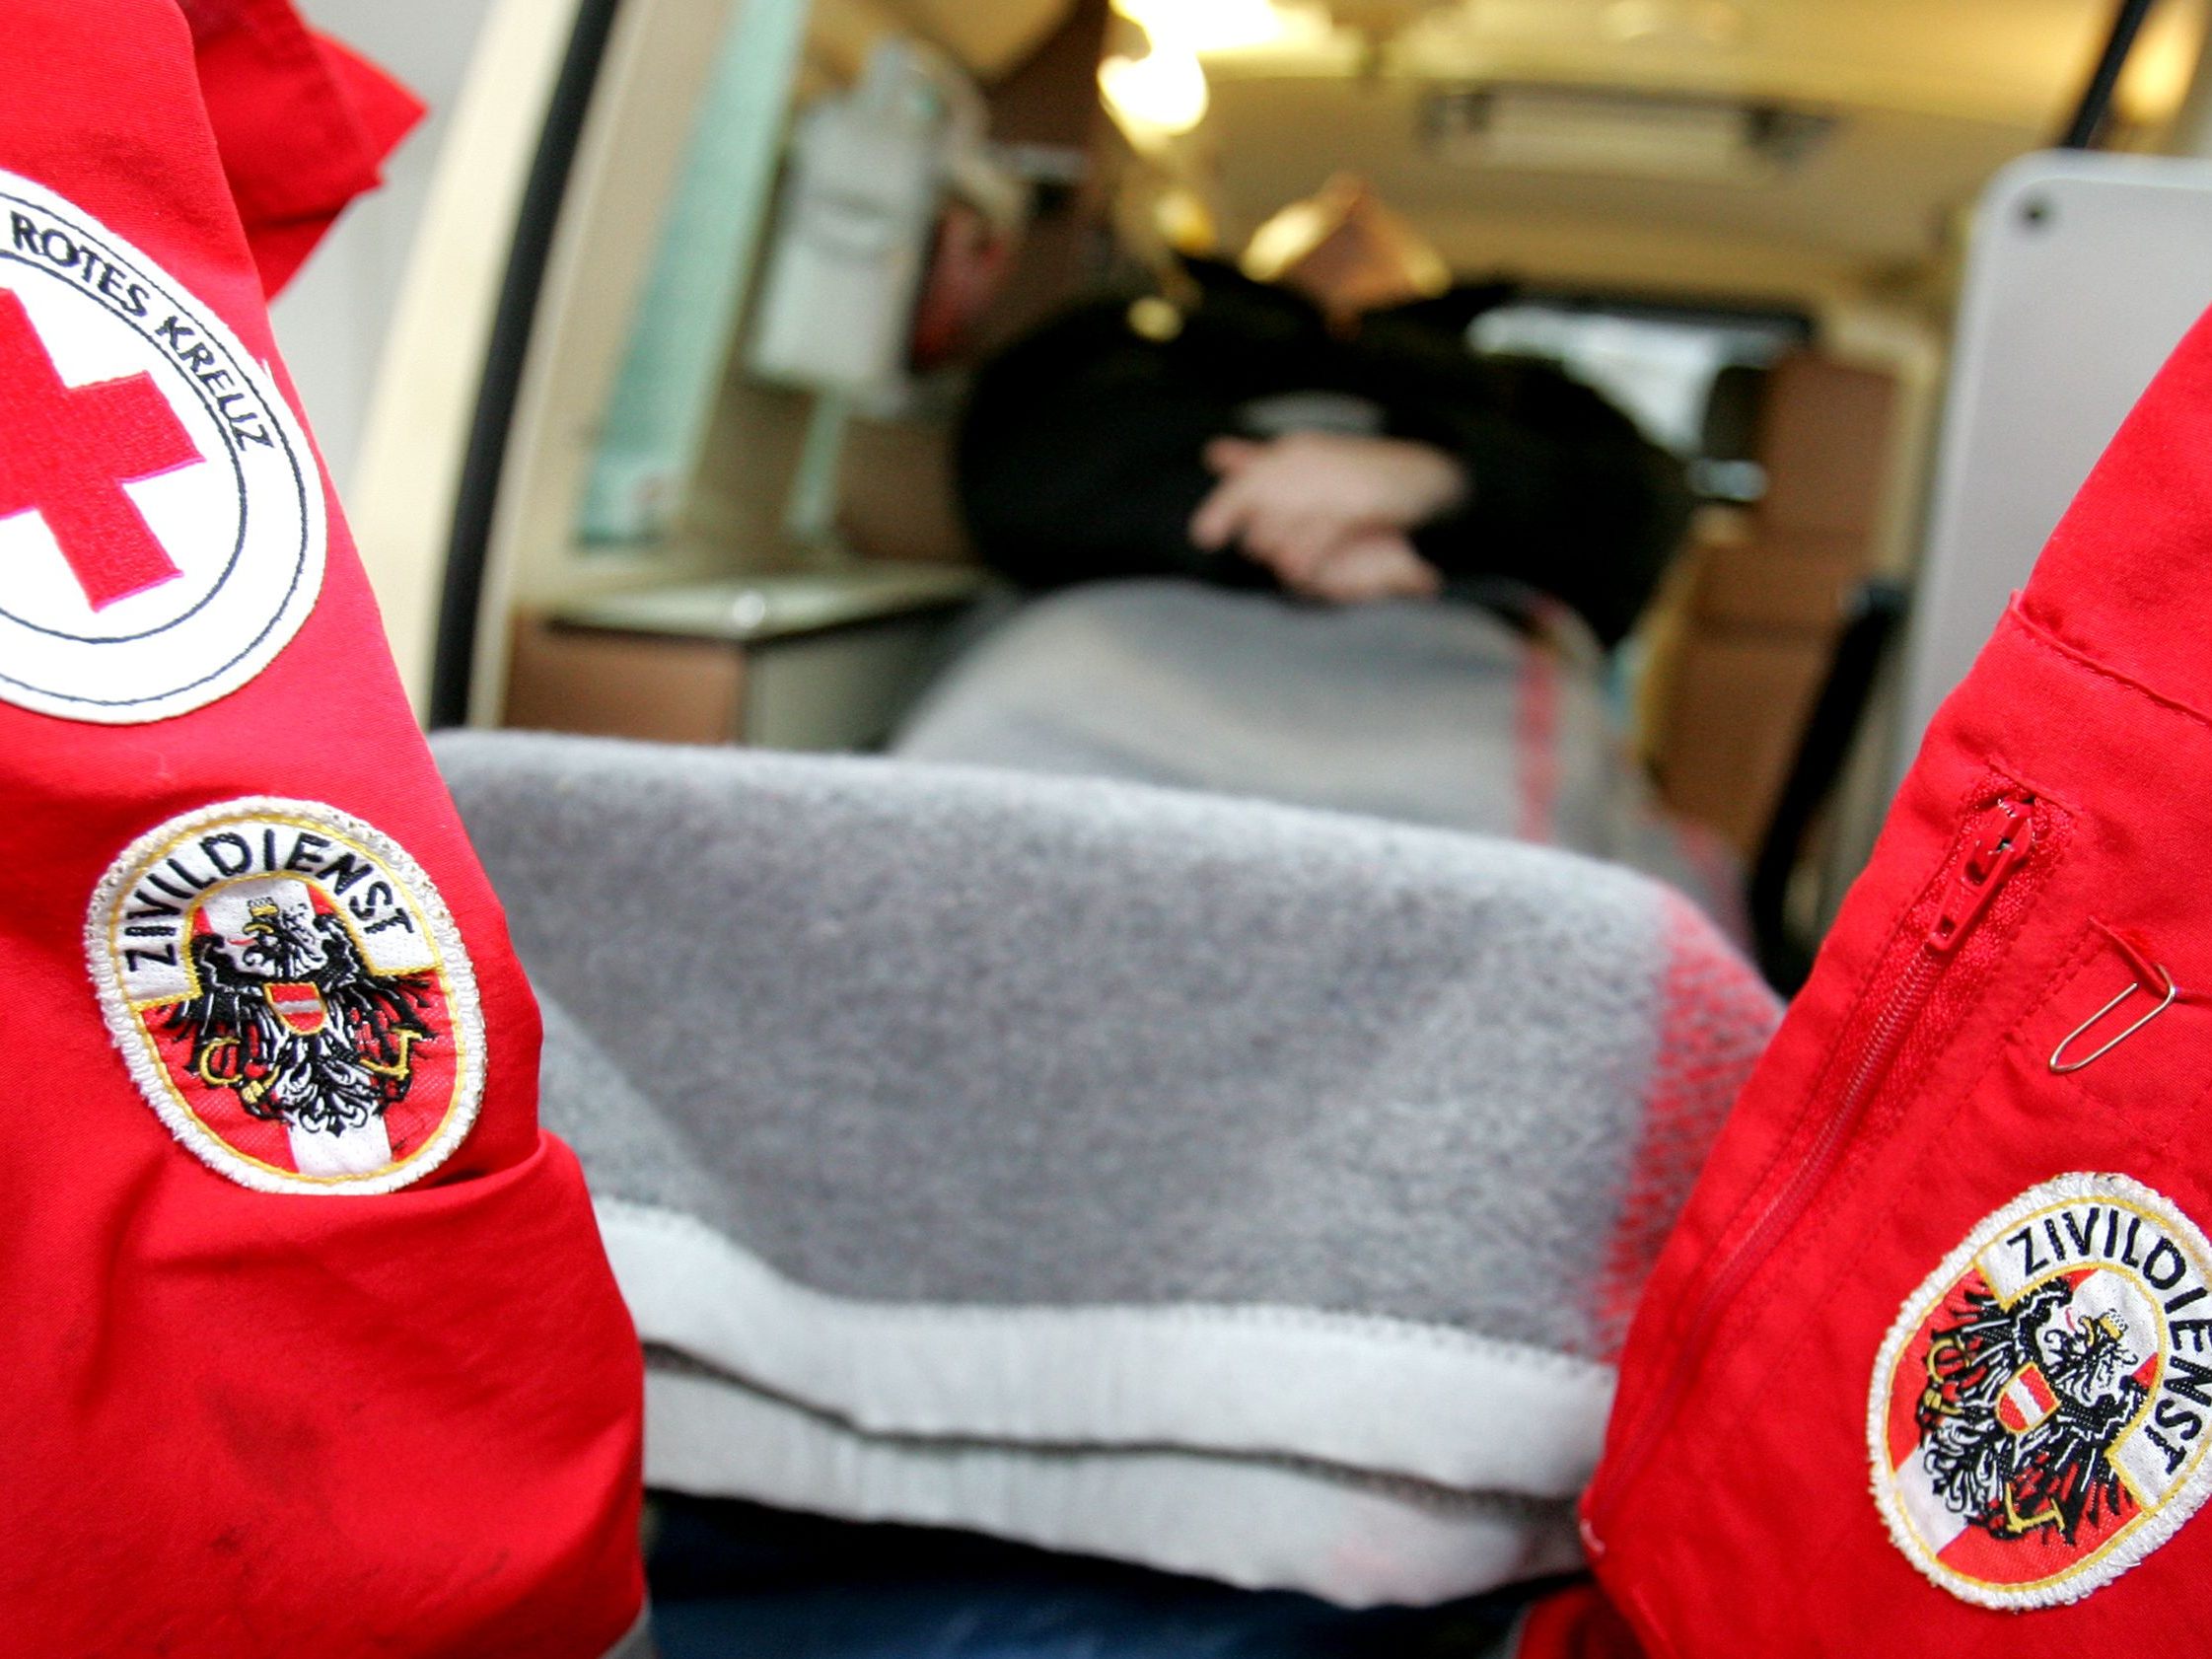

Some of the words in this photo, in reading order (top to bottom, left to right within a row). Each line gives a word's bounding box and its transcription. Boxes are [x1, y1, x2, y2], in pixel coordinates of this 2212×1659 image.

[11, 210, 150, 317] ROTES
[155, 316, 275, 452] KREUZ
[124, 829, 414, 972] ZIVILDIENST
[2007, 1207, 2212, 1475] ZIVILDIENST
